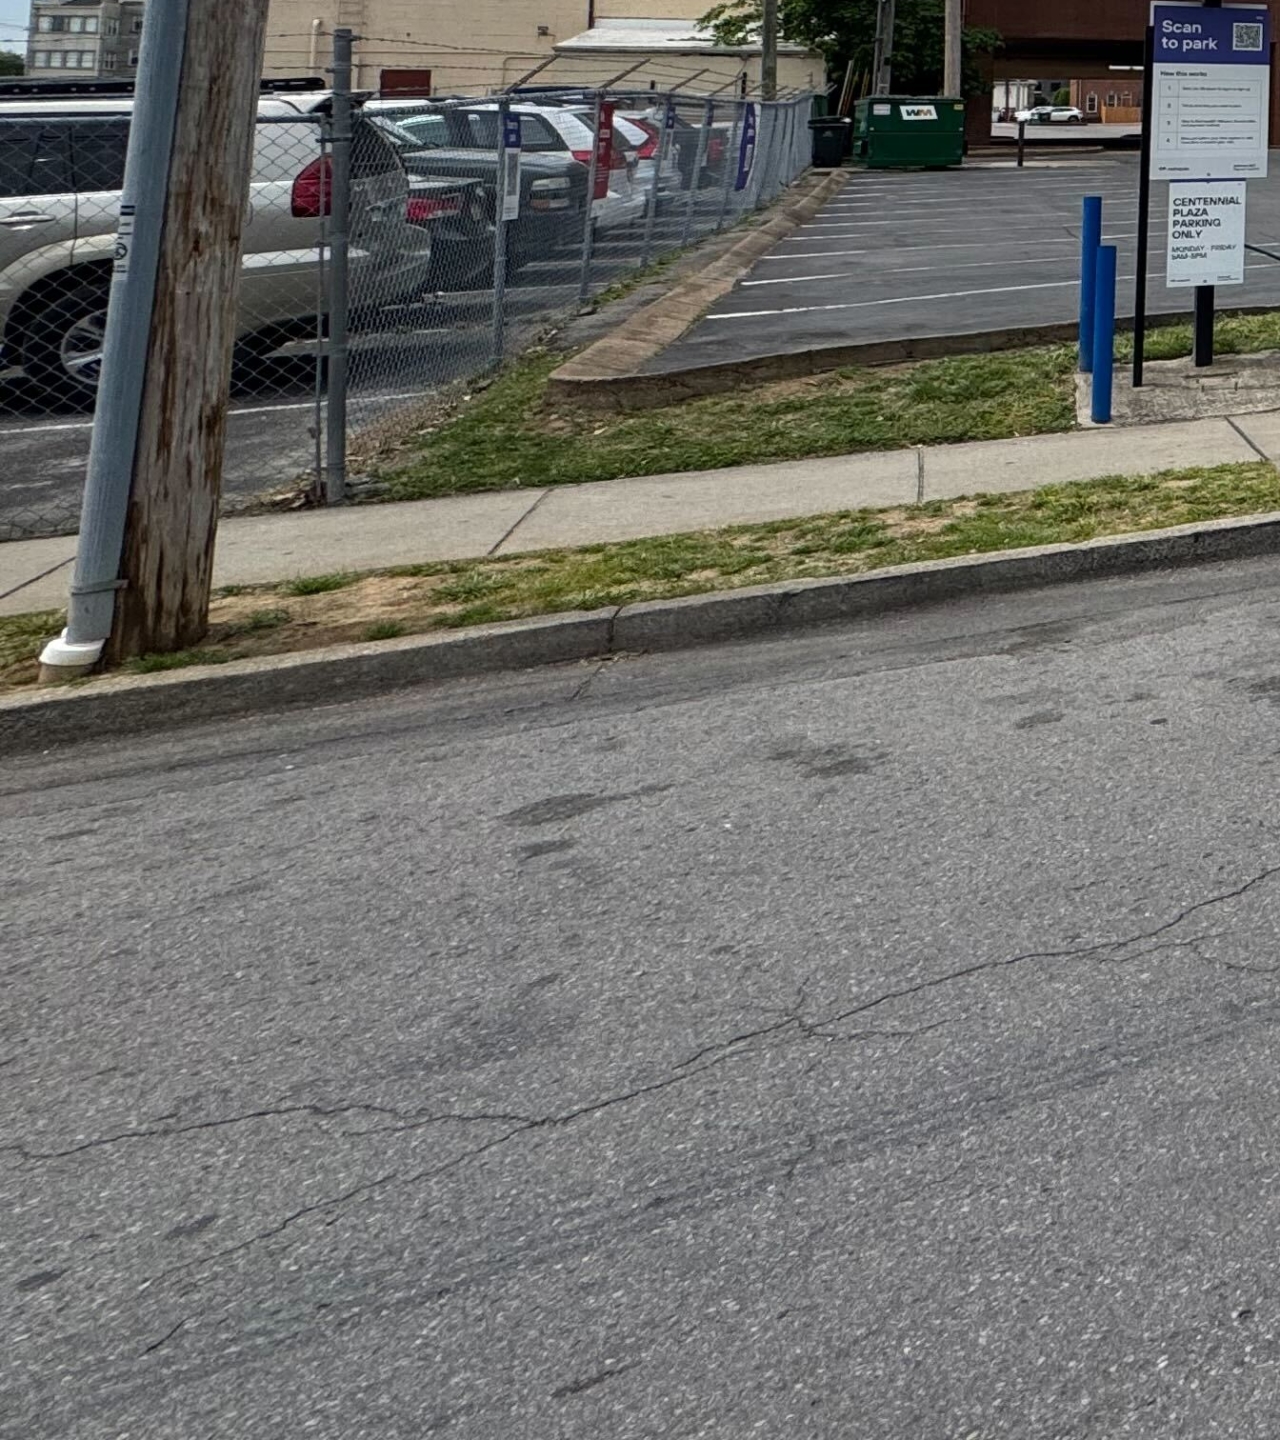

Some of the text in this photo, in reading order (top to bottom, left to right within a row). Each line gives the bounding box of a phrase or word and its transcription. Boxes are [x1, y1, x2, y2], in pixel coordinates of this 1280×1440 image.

[1162, 19, 1202, 34] Scan
[1162, 37, 1218, 53] to park
[1173, 196, 1242, 206] CENTENNIAL
[1173, 208, 1209, 218] PLAZA
[1173, 218, 1221, 229] PARKING
[1172, 230, 1203, 239] ONLY
[1171, 245, 1205, 253] MONDAY
[1210, 244, 1237, 252] FRIDAY
